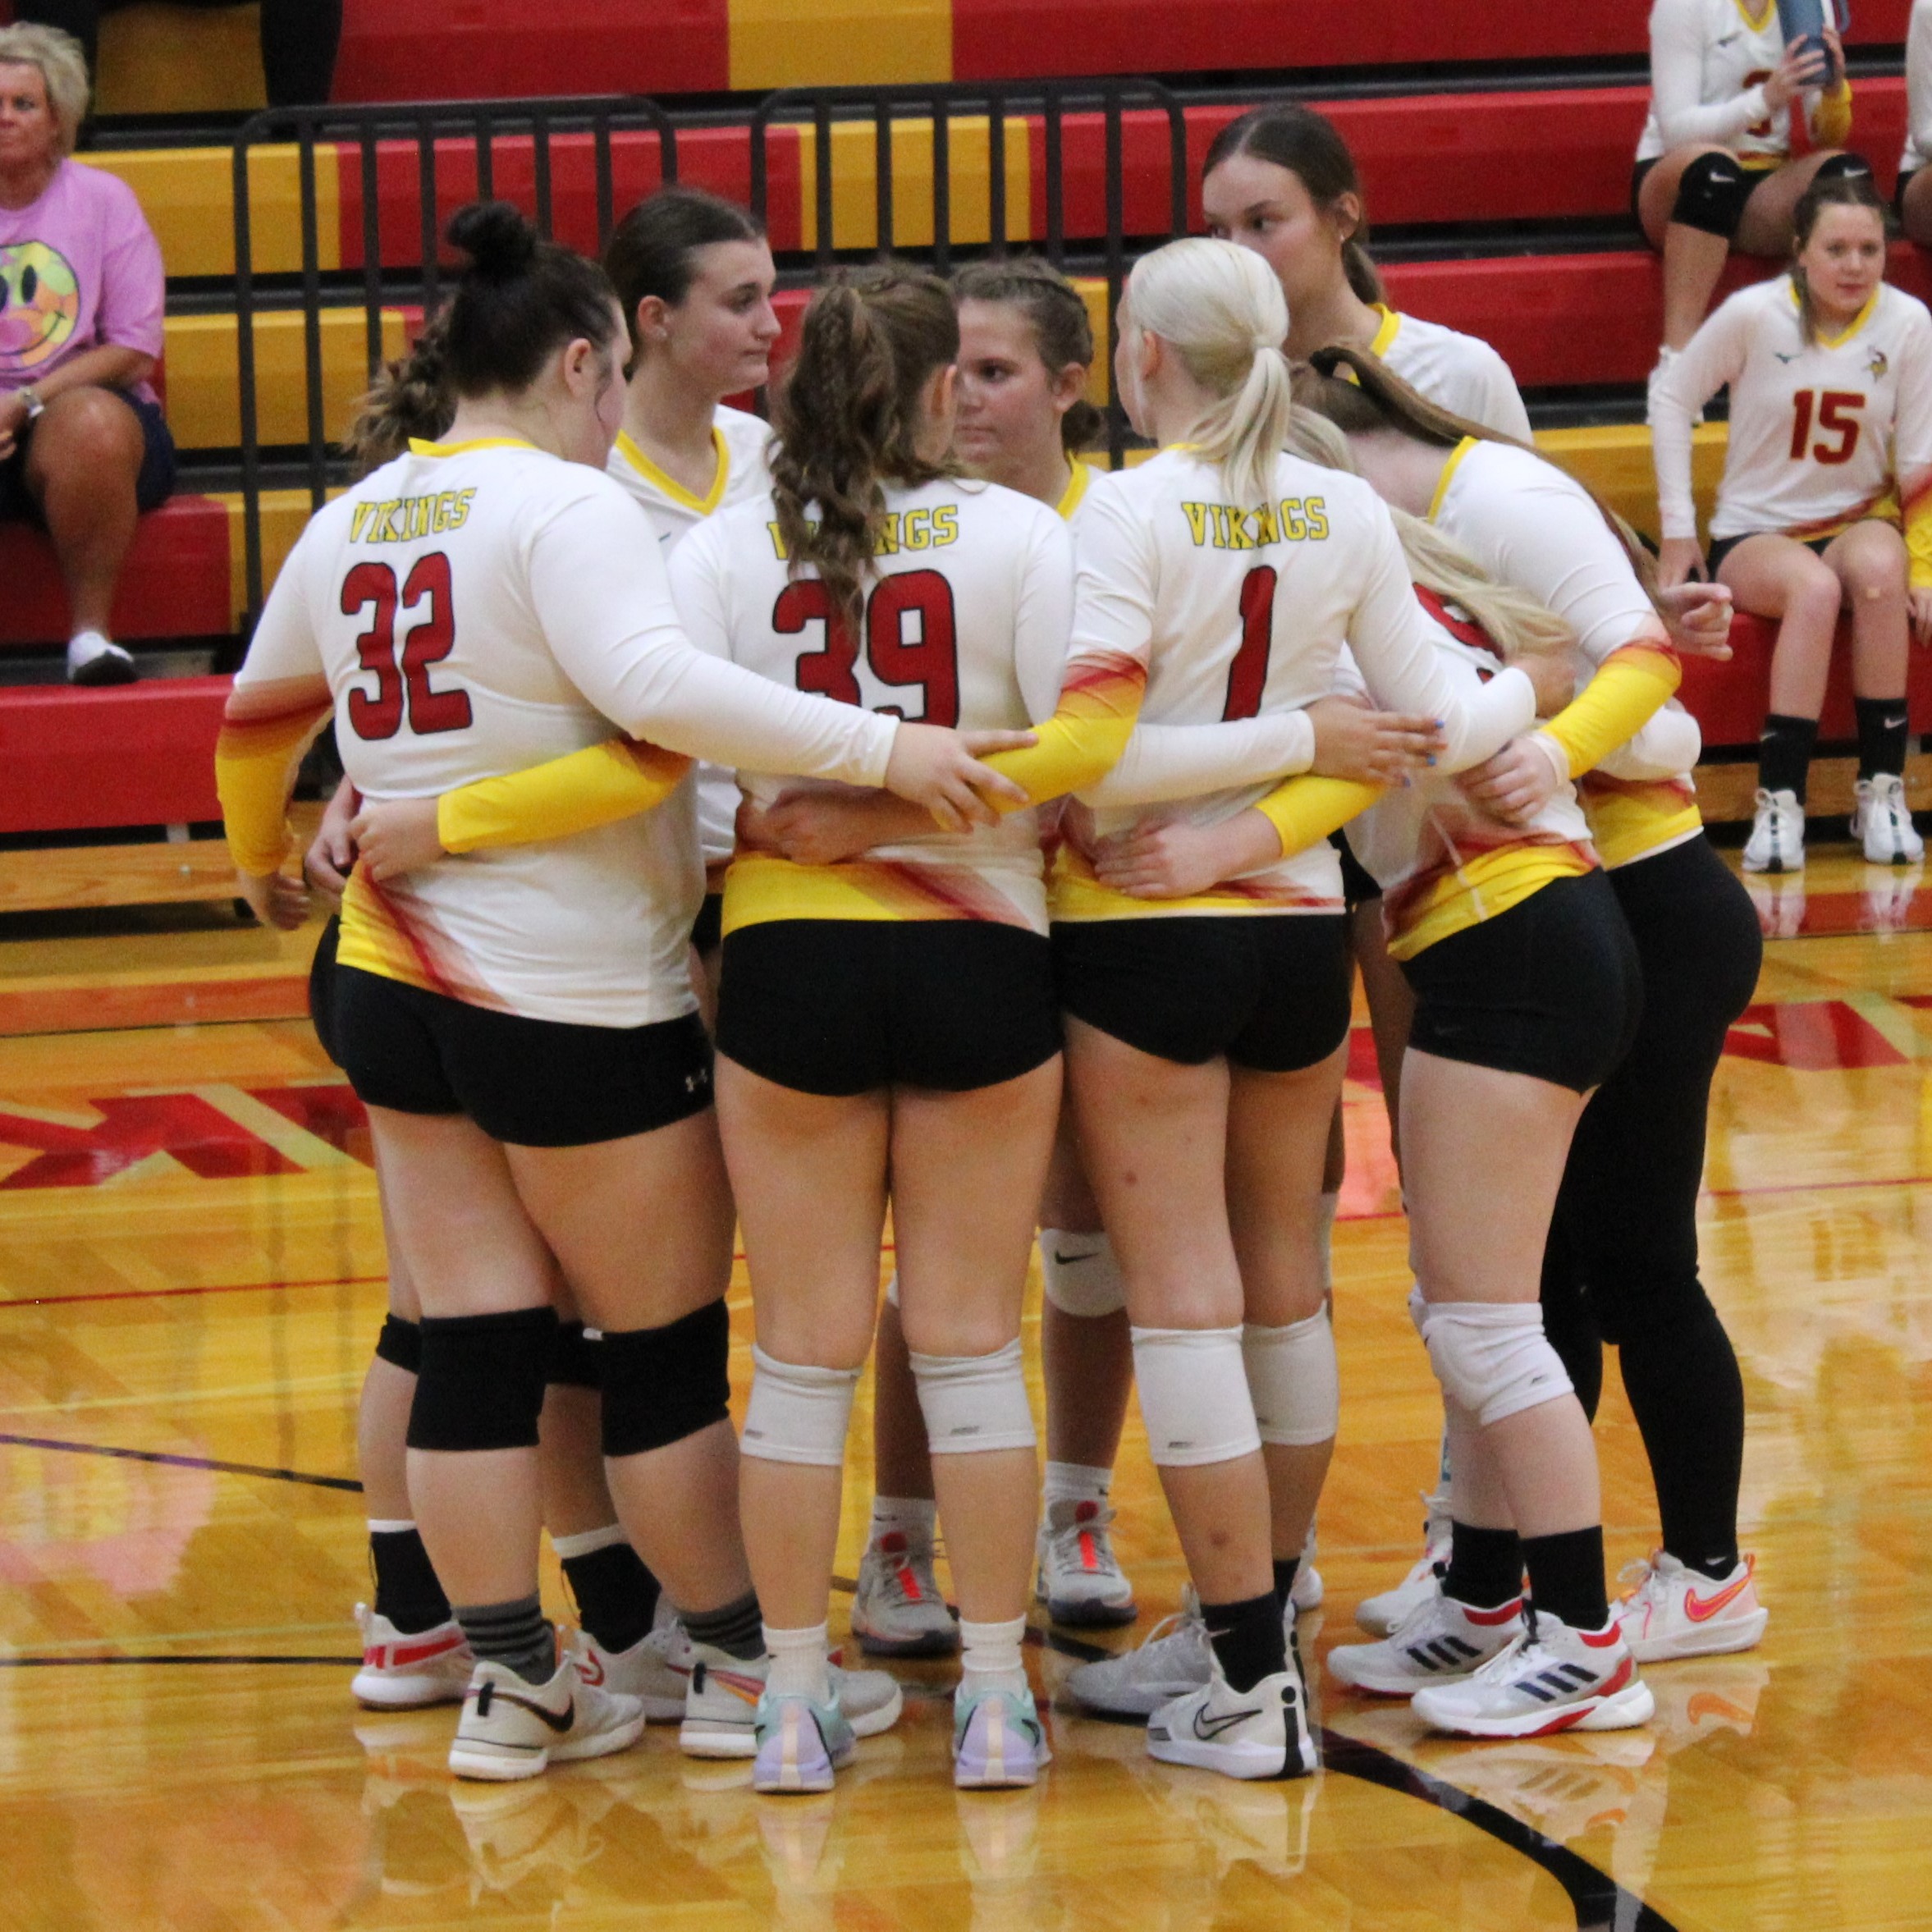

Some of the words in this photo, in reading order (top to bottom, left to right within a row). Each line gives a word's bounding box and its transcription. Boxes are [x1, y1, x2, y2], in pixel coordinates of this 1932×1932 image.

[1790, 390, 1866, 465] 15
[350, 488, 477, 543] VIKINGS
[341, 552, 474, 740] 32
[1221, 565, 1277, 722] 1
